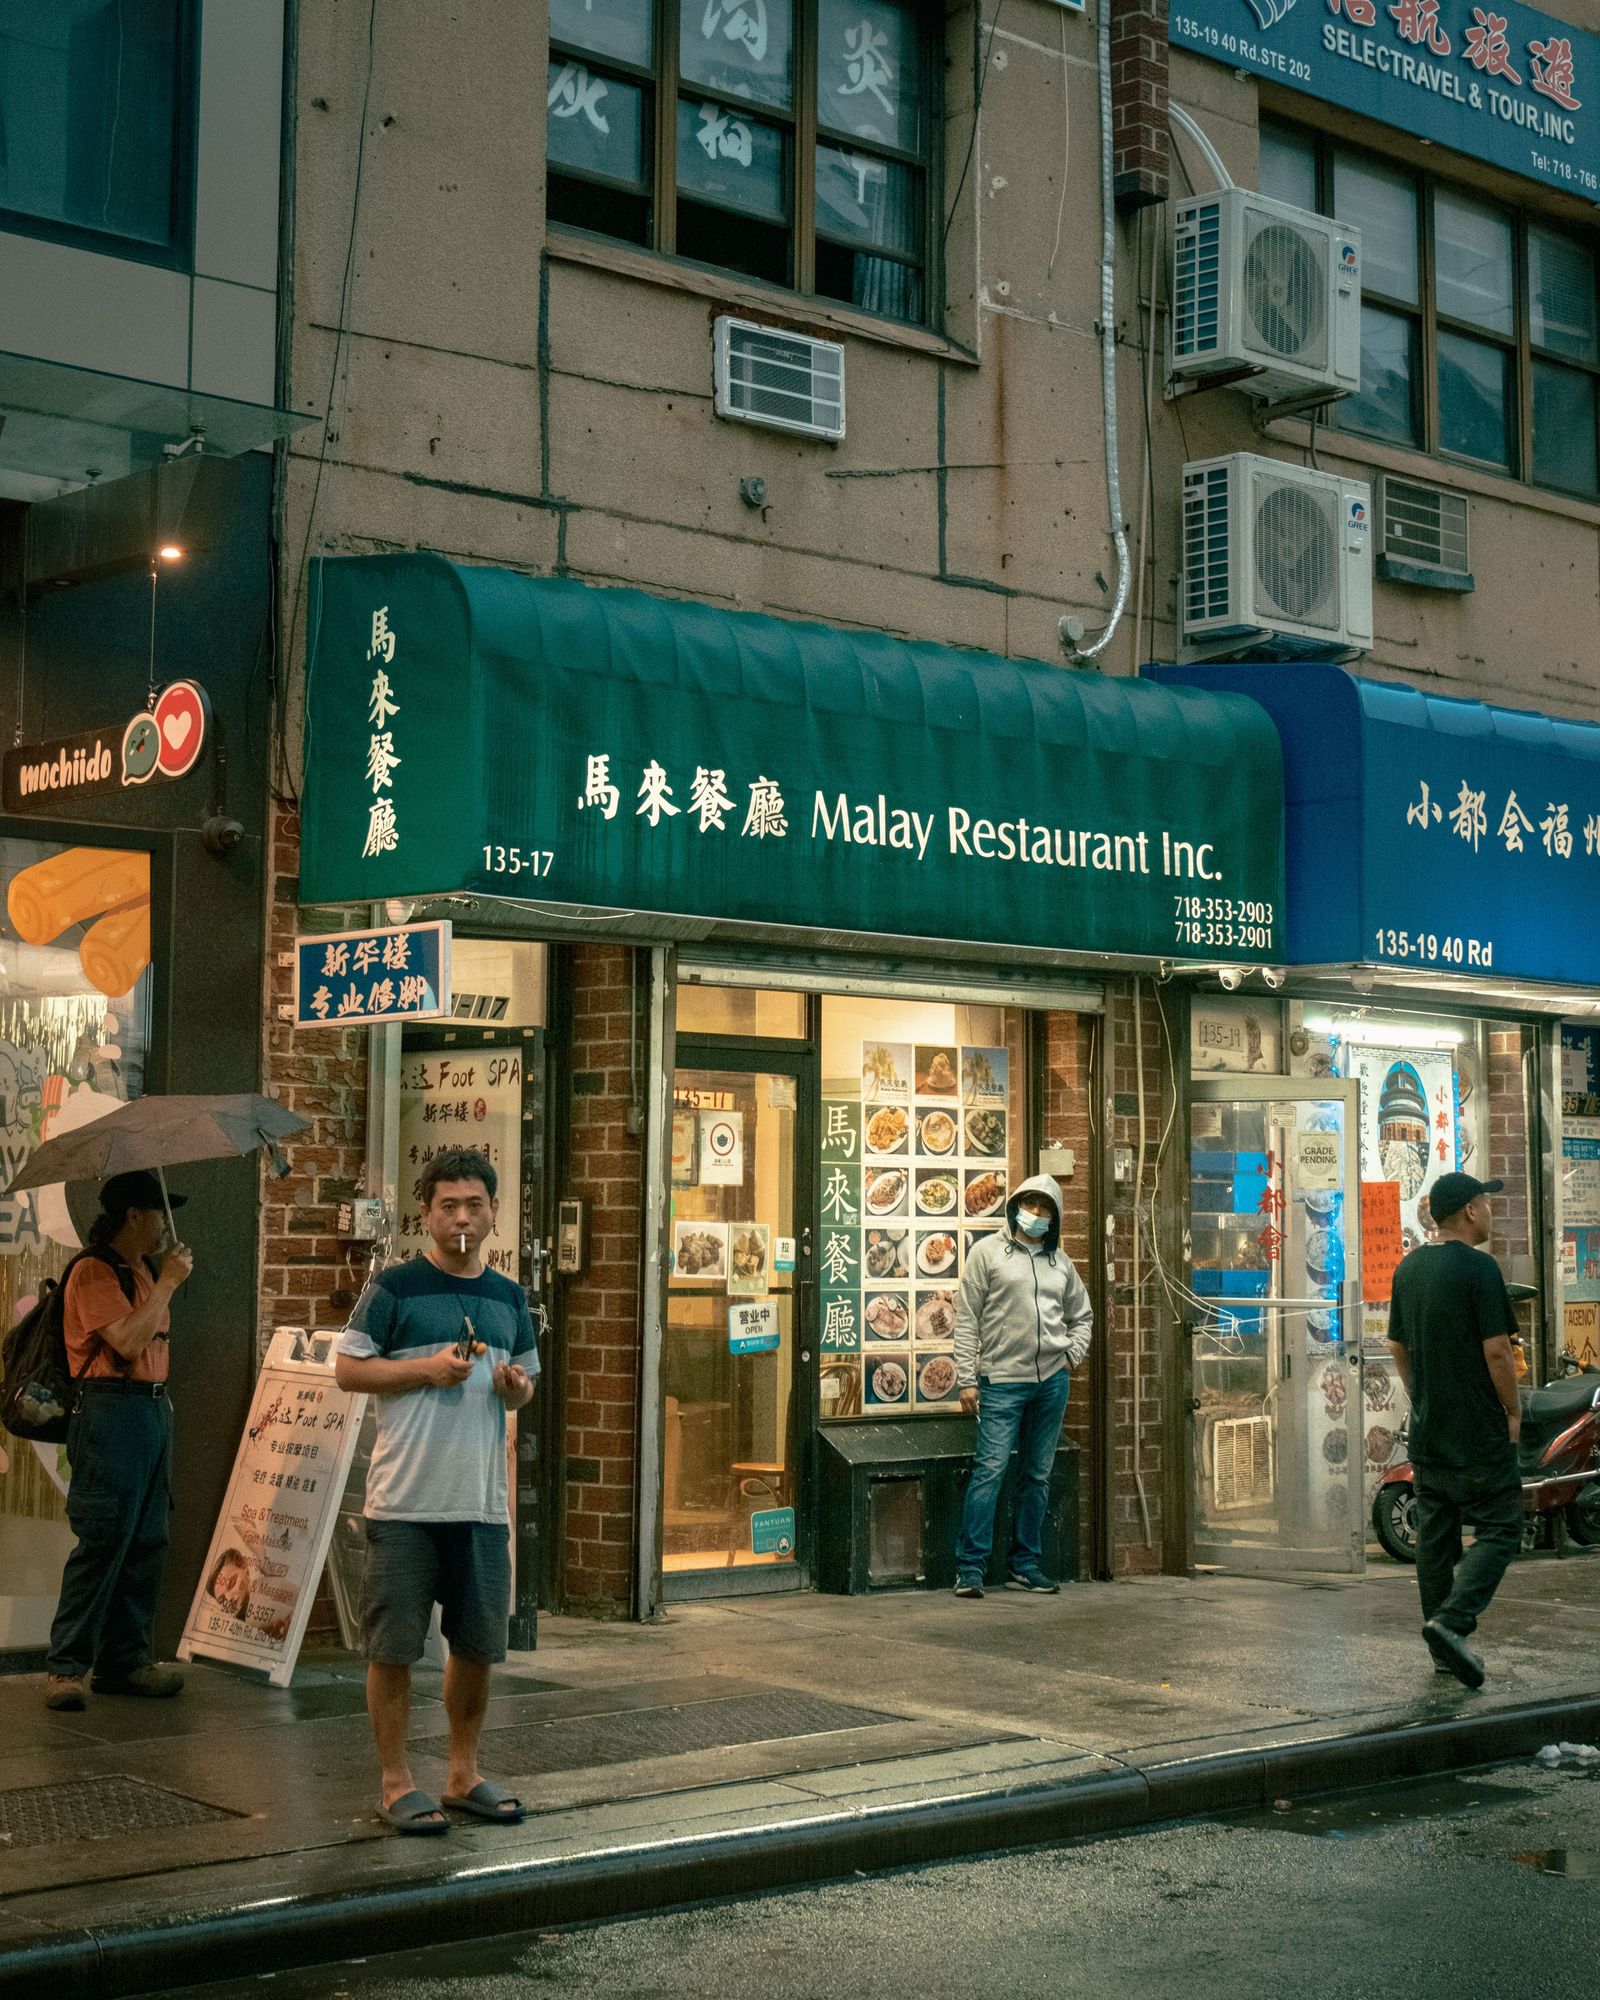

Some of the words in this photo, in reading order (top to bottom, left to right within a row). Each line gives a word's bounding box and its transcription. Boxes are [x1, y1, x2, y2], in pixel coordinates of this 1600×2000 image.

[1175, 15, 1219, 46] 135-19
[1221, 33, 1237, 53] 40
[1289, 58, 1312, 82] 202
[1322, 23, 1466, 104] SELECTRAVEL
[1468, 82, 1482, 110] &
[1487, 88, 1575, 145] TOUR,INC
[1530, 151, 1550, 173] Tel:
[1552, 159, 1572, 180] 718
[1579, 169, 1597, 190] 766
[1337, 263, 1360, 276] GREE
[1348, 520, 1369, 532] GREE
[361, 605, 402, 859] 馬來餐廳
[19, 739, 112, 796] mochiido
[577, 753, 790, 840] 馬來餐廳
[811, 790, 934, 861] Malay
[948, 806, 1150, 874] Restaurant
[1162, 831, 1223, 881] Inc.
[482, 845, 555, 877] 135-17
[1174, 895, 1274, 925] 718-353-2903
[1174, 921, 1273, 949] 718-353-2901
[1375, 928, 1438, 961] 135-19
[1441, 936, 1464, 964] 40
[1467, 938, 1493, 967] Rd
[321, 933, 412, 978] 新华楼
[310, 974, 428, 1020] 专业修脚
[452, 993, 508, 1019] -17
[1203, 1024, 1241, 1049] 135-19
[438, 1061, 475, 1091] Foot
[487, 1058, 520, 1089] SPA
[422, 1101, 469, 1124] 新华楼
[1300, 1156, 1337, 1164] PENDING
[1304, 1146, 1334, 1156] GRADE
[1257, 1151, 1287, 1261] 小都會
[820, 1104, 858, 1350] 馬來餐廳
[781, 1241, 790, 1254] 拉
[739, 1307, 771, 1326] 营业中
[1568, 1308, 1596, 1328] AGENCY
[745, 1325, 763, 1335] OPEN
[294, 1407, 318, 1427] Foot
[323, 1412, 345, 1432] SPA
[241, 1504, 257, 1519] Spa
[754, 1516, 792, 1529] FANTUAN
[242, 1530, 260, 1544] Foot
[261, 1533, 293, 1553] Massage
[263, 1556, 291, 1575] Therapy
[260, 1583, 295, 1602] Massage
